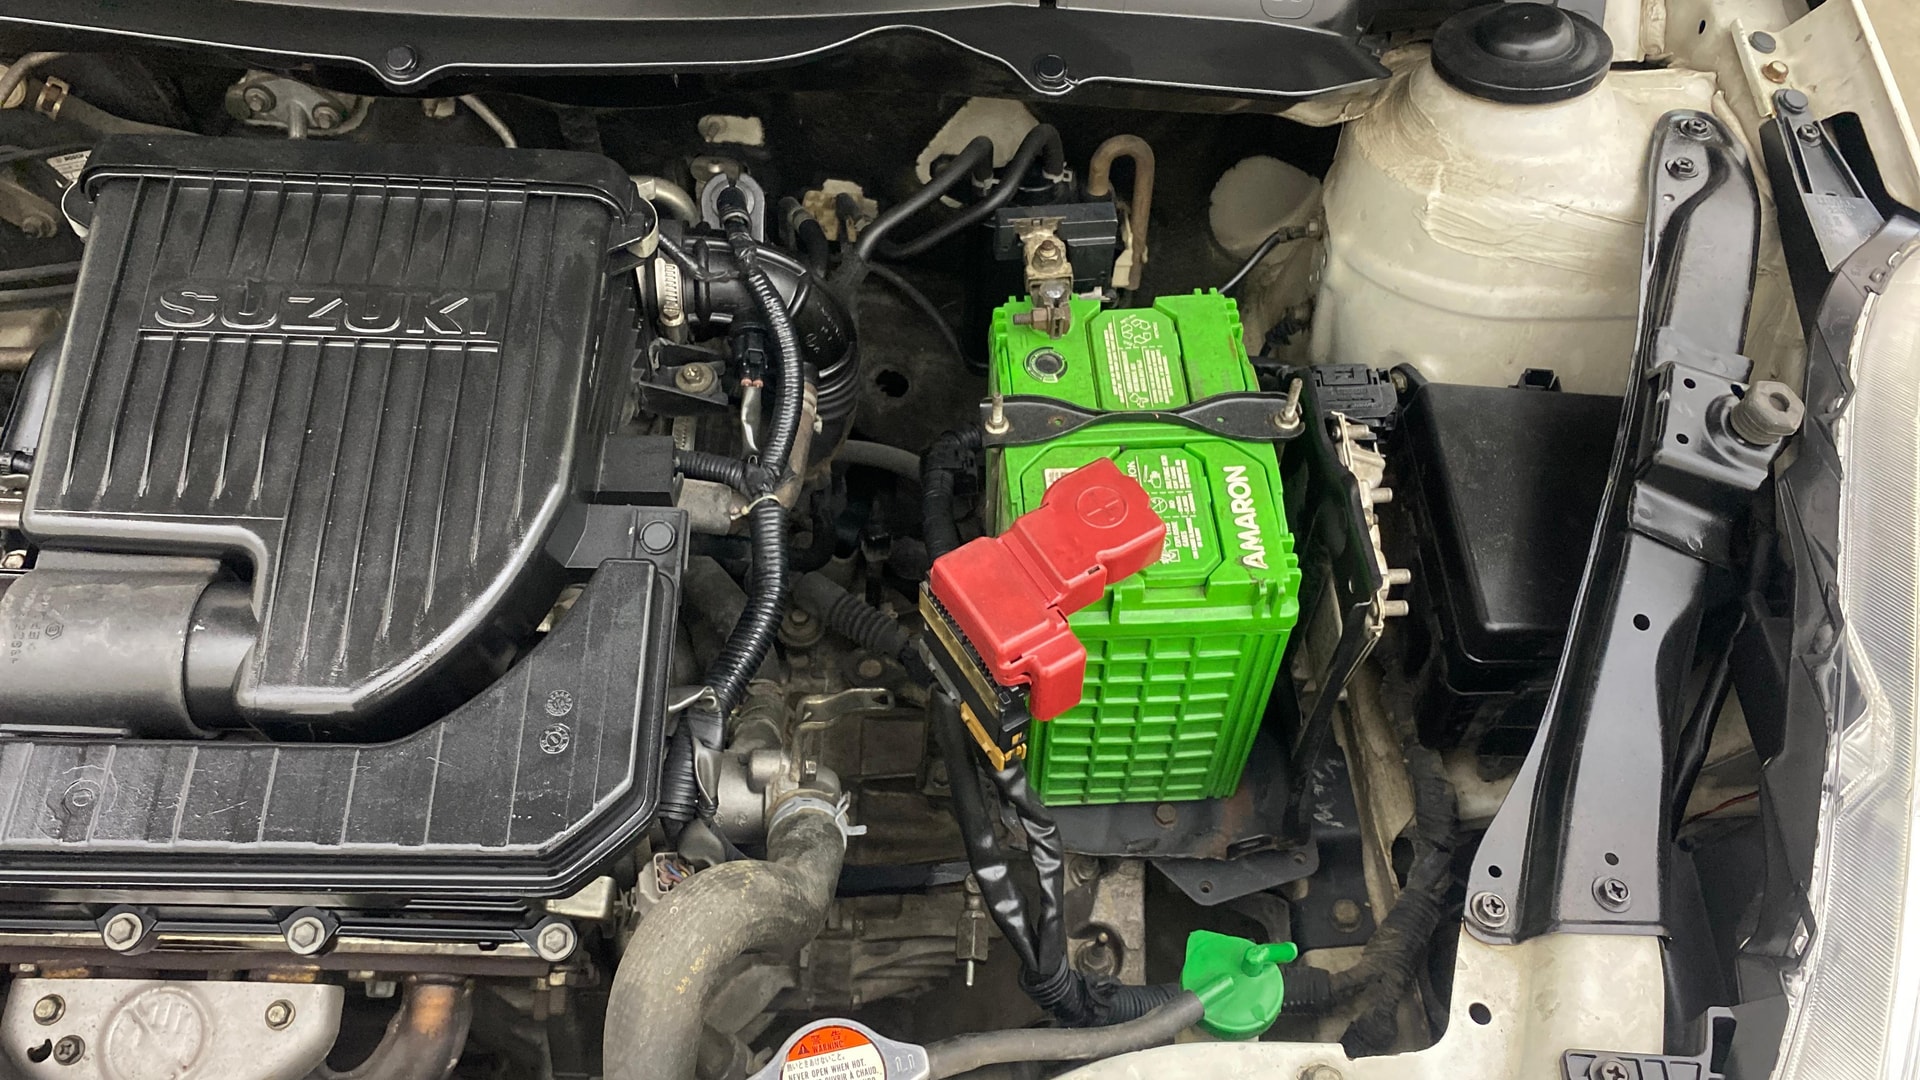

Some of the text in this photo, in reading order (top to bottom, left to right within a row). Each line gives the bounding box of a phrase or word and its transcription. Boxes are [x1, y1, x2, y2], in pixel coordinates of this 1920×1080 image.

[155, 288, 494, 335] SUZUKI
[1223, 465, 1269, 569] AMARON
[788, 1058, 867, 1080] NEVER OPEN WHEN HOT.
